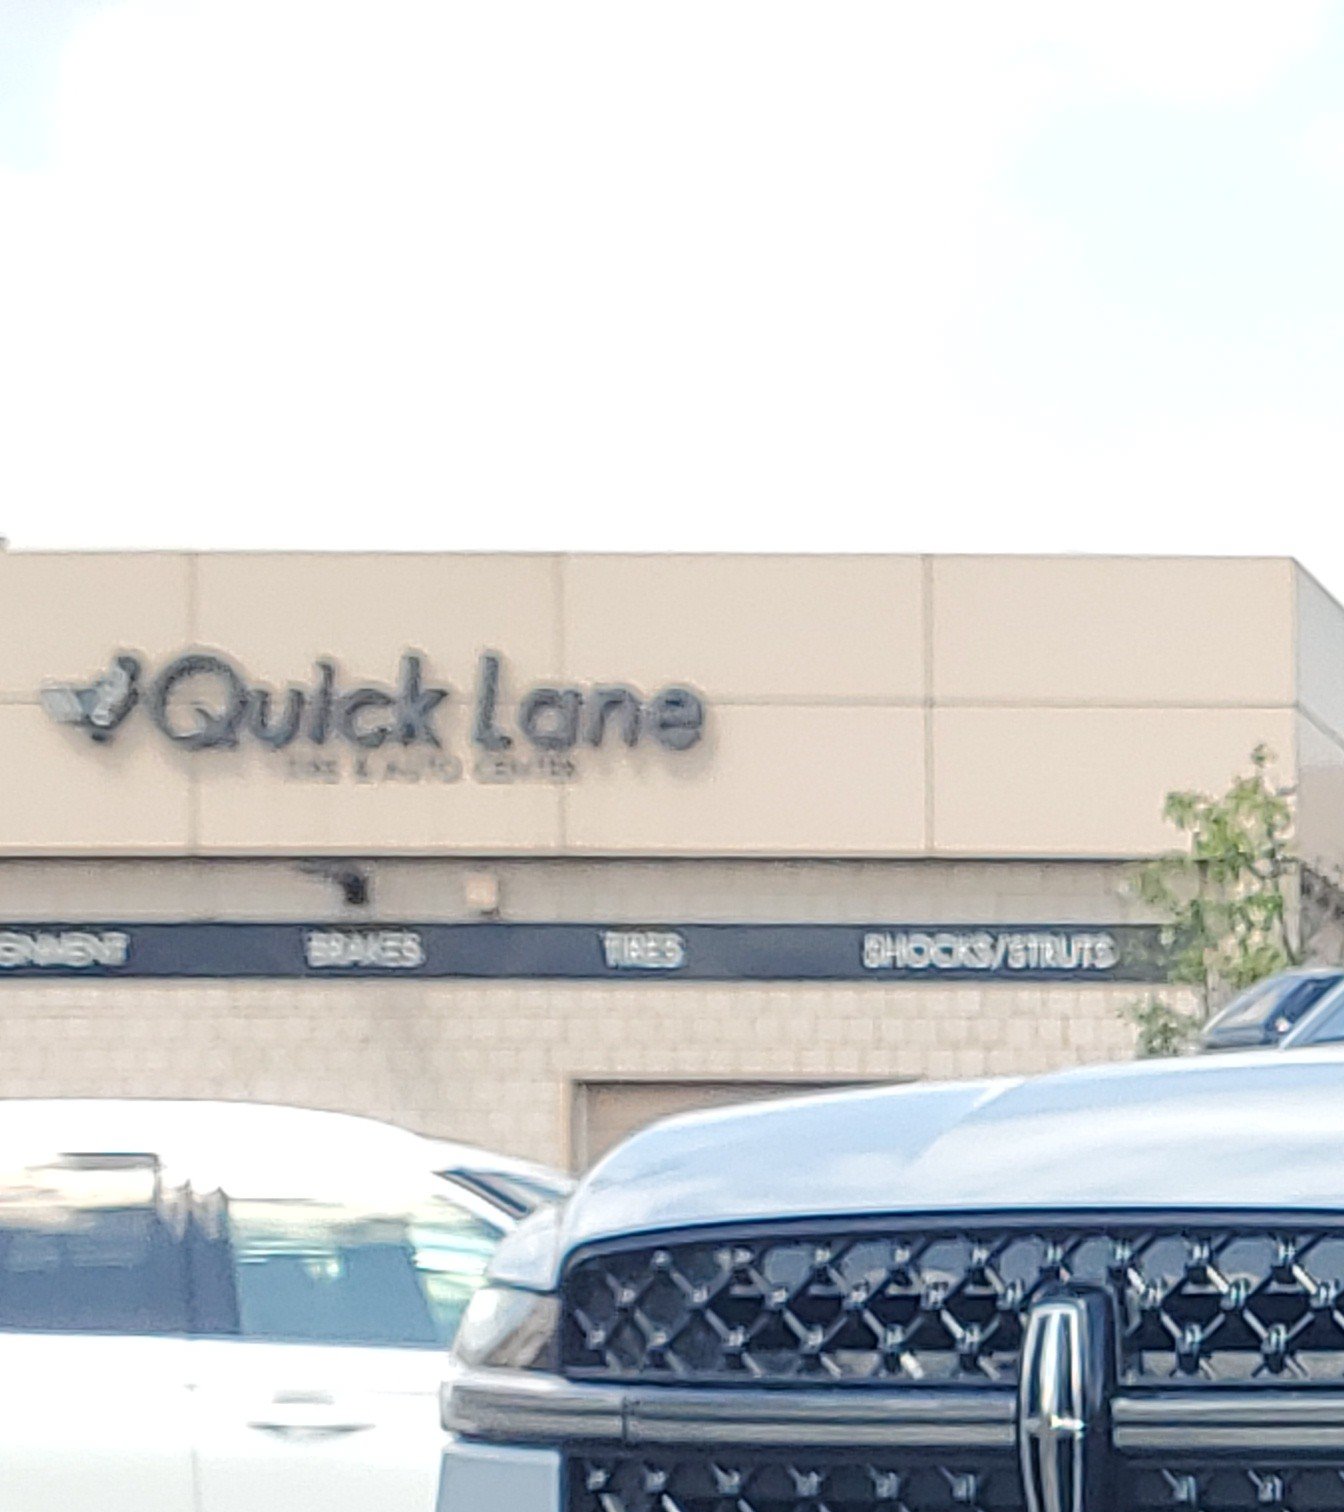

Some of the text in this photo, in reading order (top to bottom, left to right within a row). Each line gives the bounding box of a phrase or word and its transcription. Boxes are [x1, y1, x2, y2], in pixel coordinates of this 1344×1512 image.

[151, 650, 704, 751] Quick Lane
[307, 932, 424, 968] BRAKES
[604, 931, 687, 968] TIRES
[863, 932, 1120, 970] SHOCKS/STRUTS
